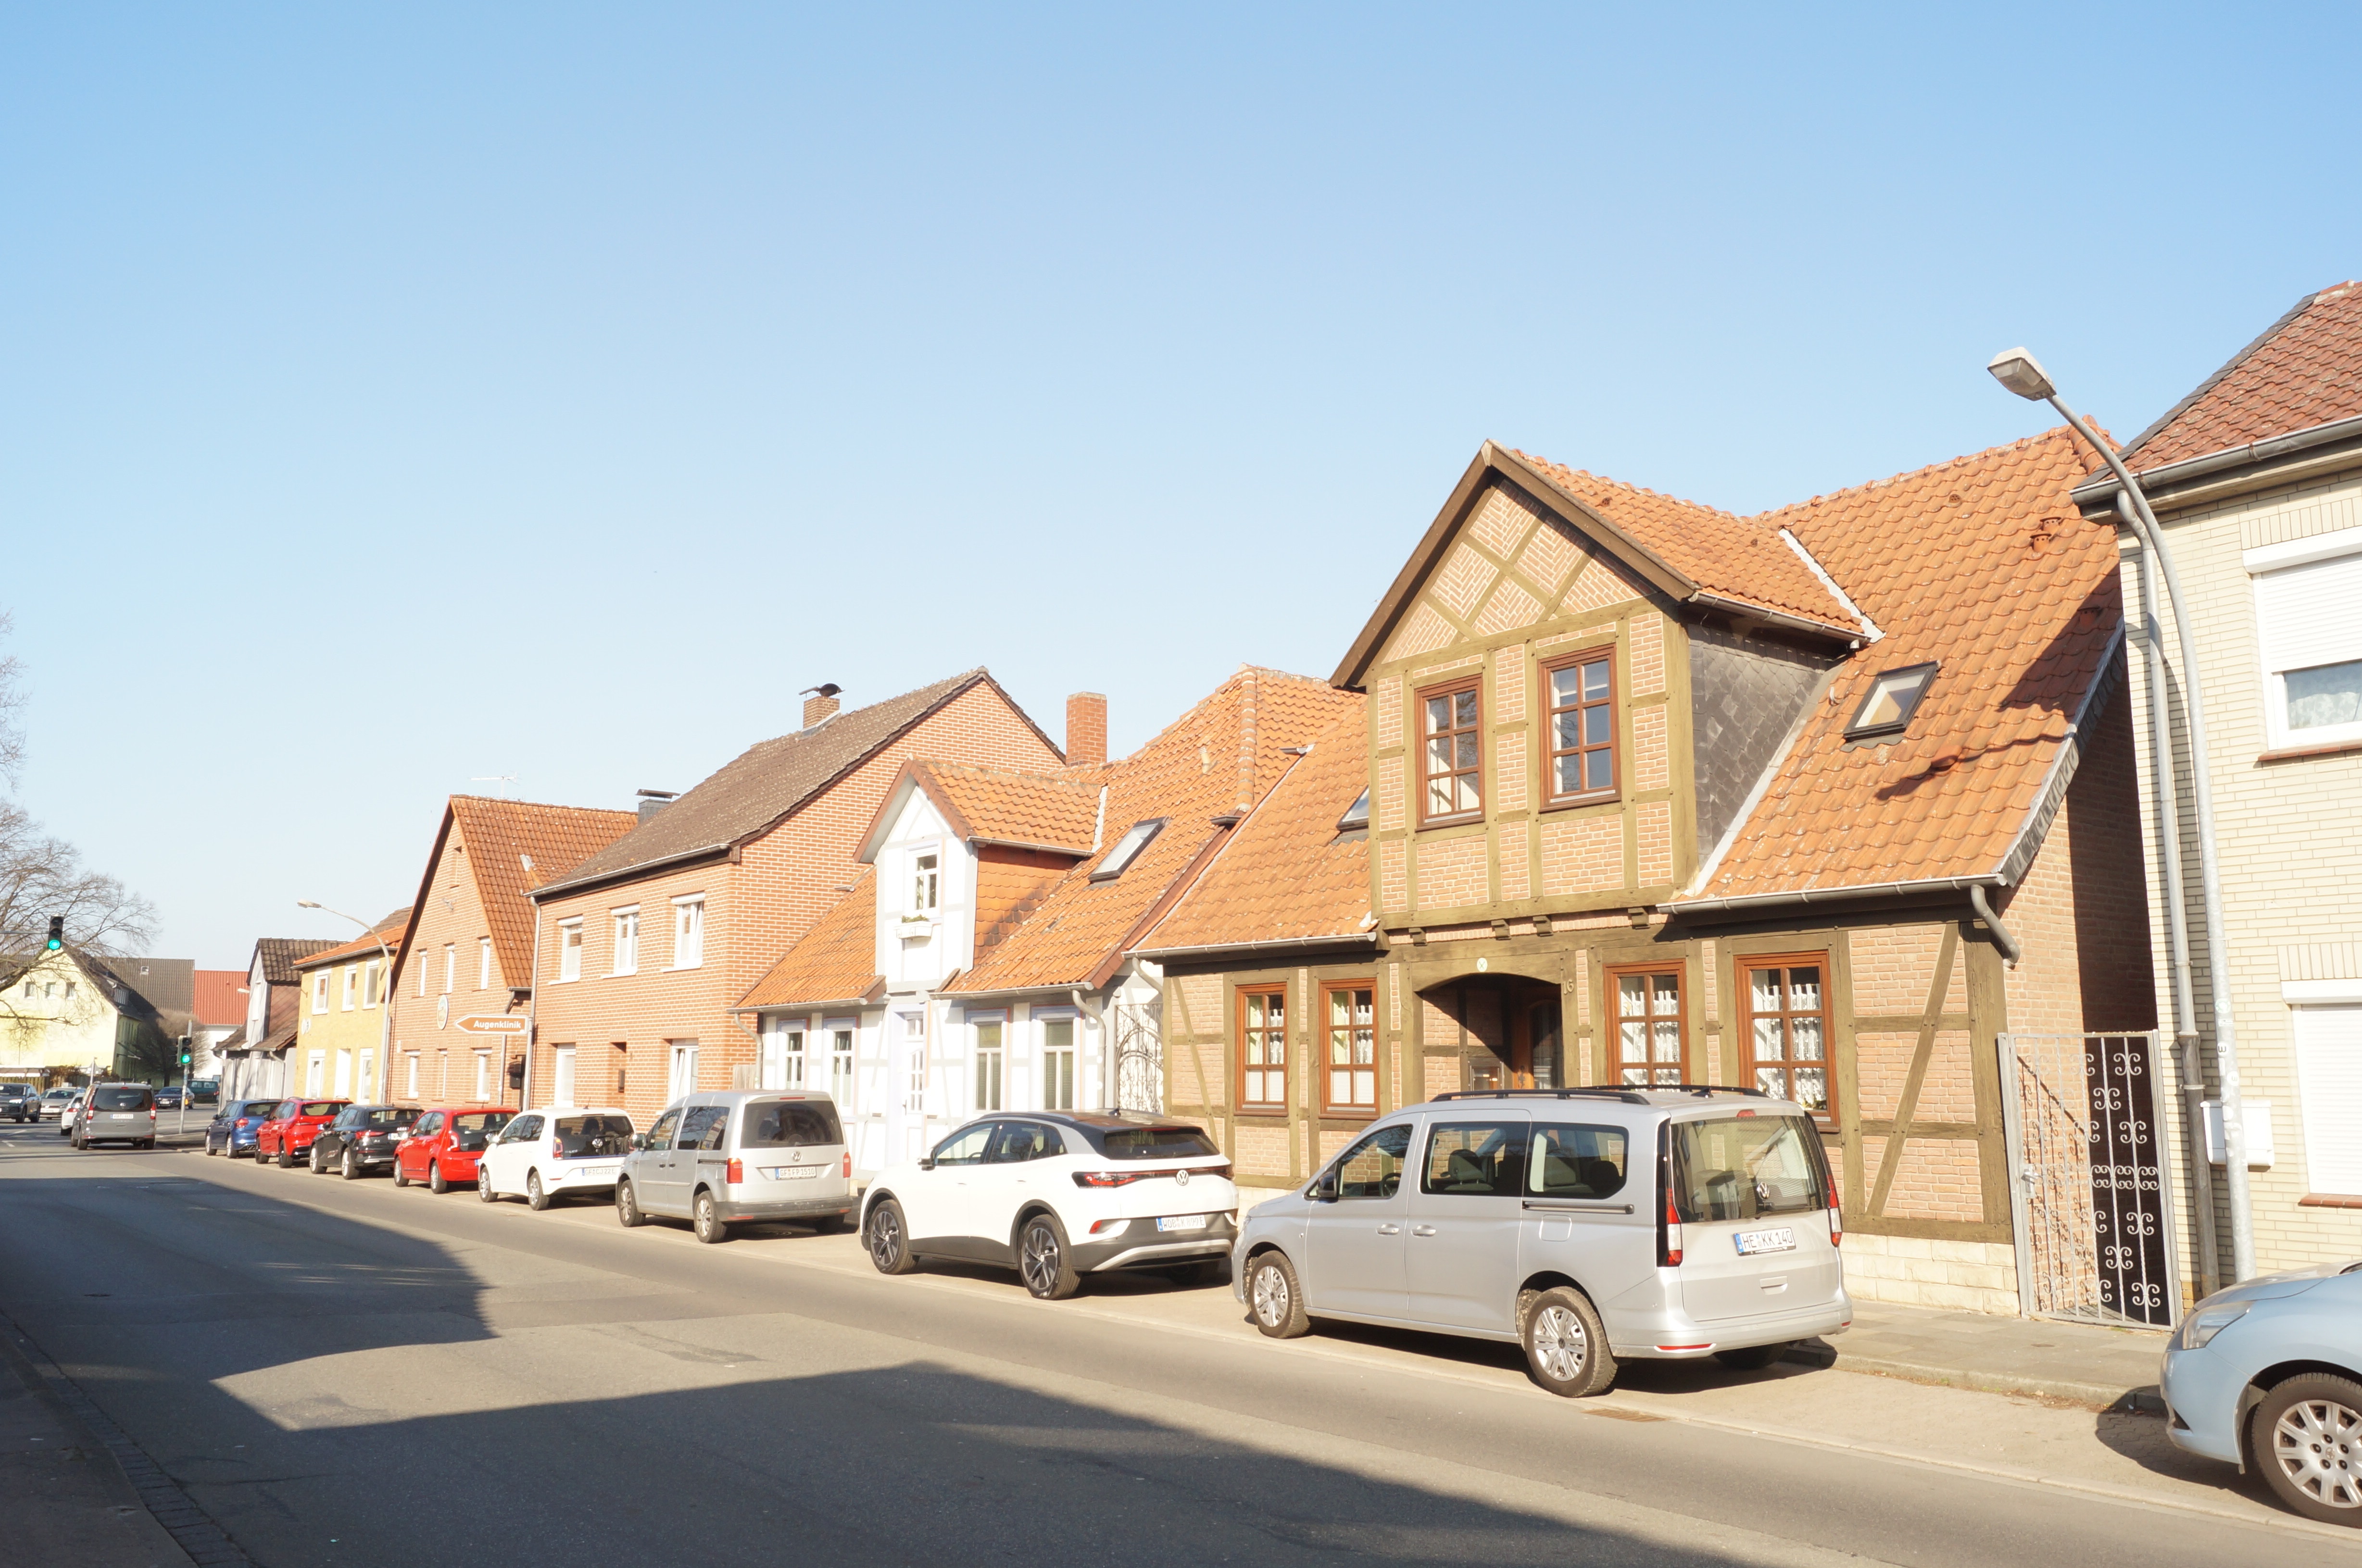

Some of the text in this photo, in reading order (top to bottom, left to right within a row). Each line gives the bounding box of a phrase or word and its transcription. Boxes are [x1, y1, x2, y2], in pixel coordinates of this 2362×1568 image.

[1563, 978, 1574, 994] 16
[473, 1020, 521, 1029] Augenklinik
[1163, 1218, 1177, 1229] WOB
[1742, 1231, 1793, 1249] HE KK 140
